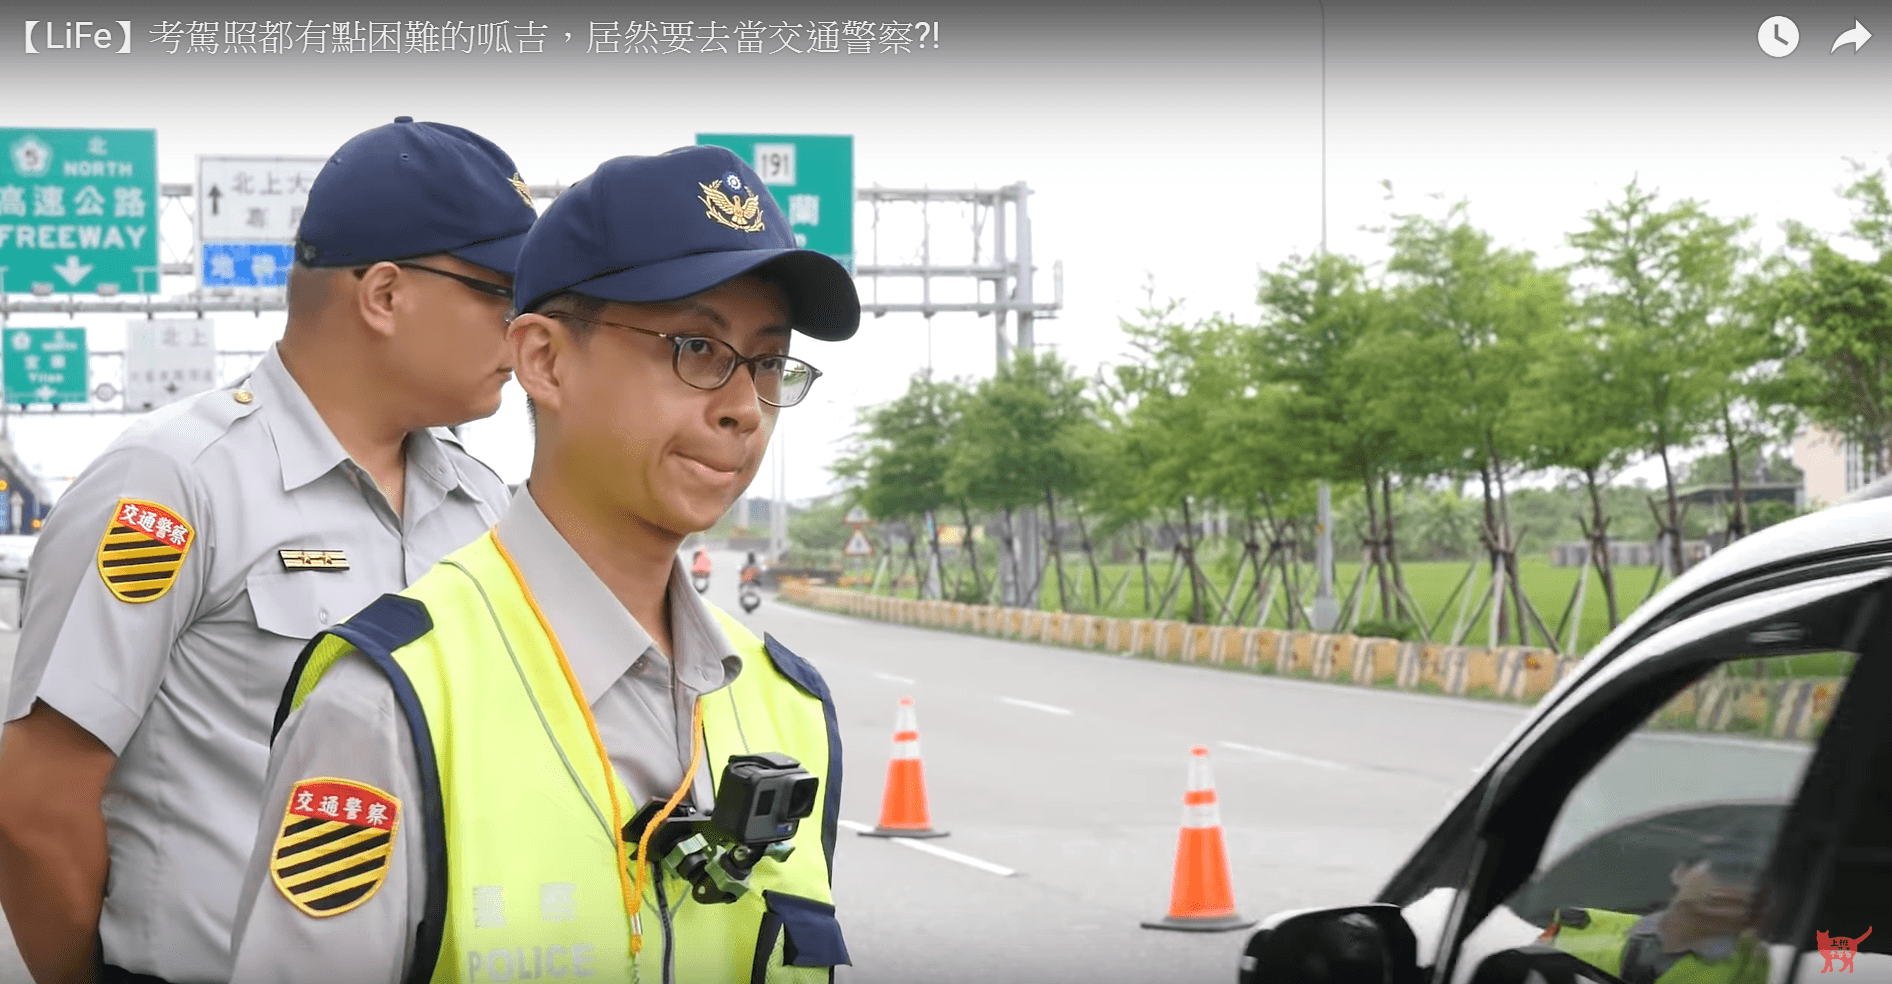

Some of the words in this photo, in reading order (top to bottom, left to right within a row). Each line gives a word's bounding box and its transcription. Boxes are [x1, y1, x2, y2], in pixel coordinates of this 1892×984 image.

[62, 160, 134, 178] NORTH
[761, 152, 790, 176] 191
[0, 184, 147, 218] 高速公路
[0, 224, 147, 249] FREEWAY
[119, 503, 190, 547] 交通警察
[294, 790, 389, 826] 交通警察
[467, 943, 596, 984] POLICE
